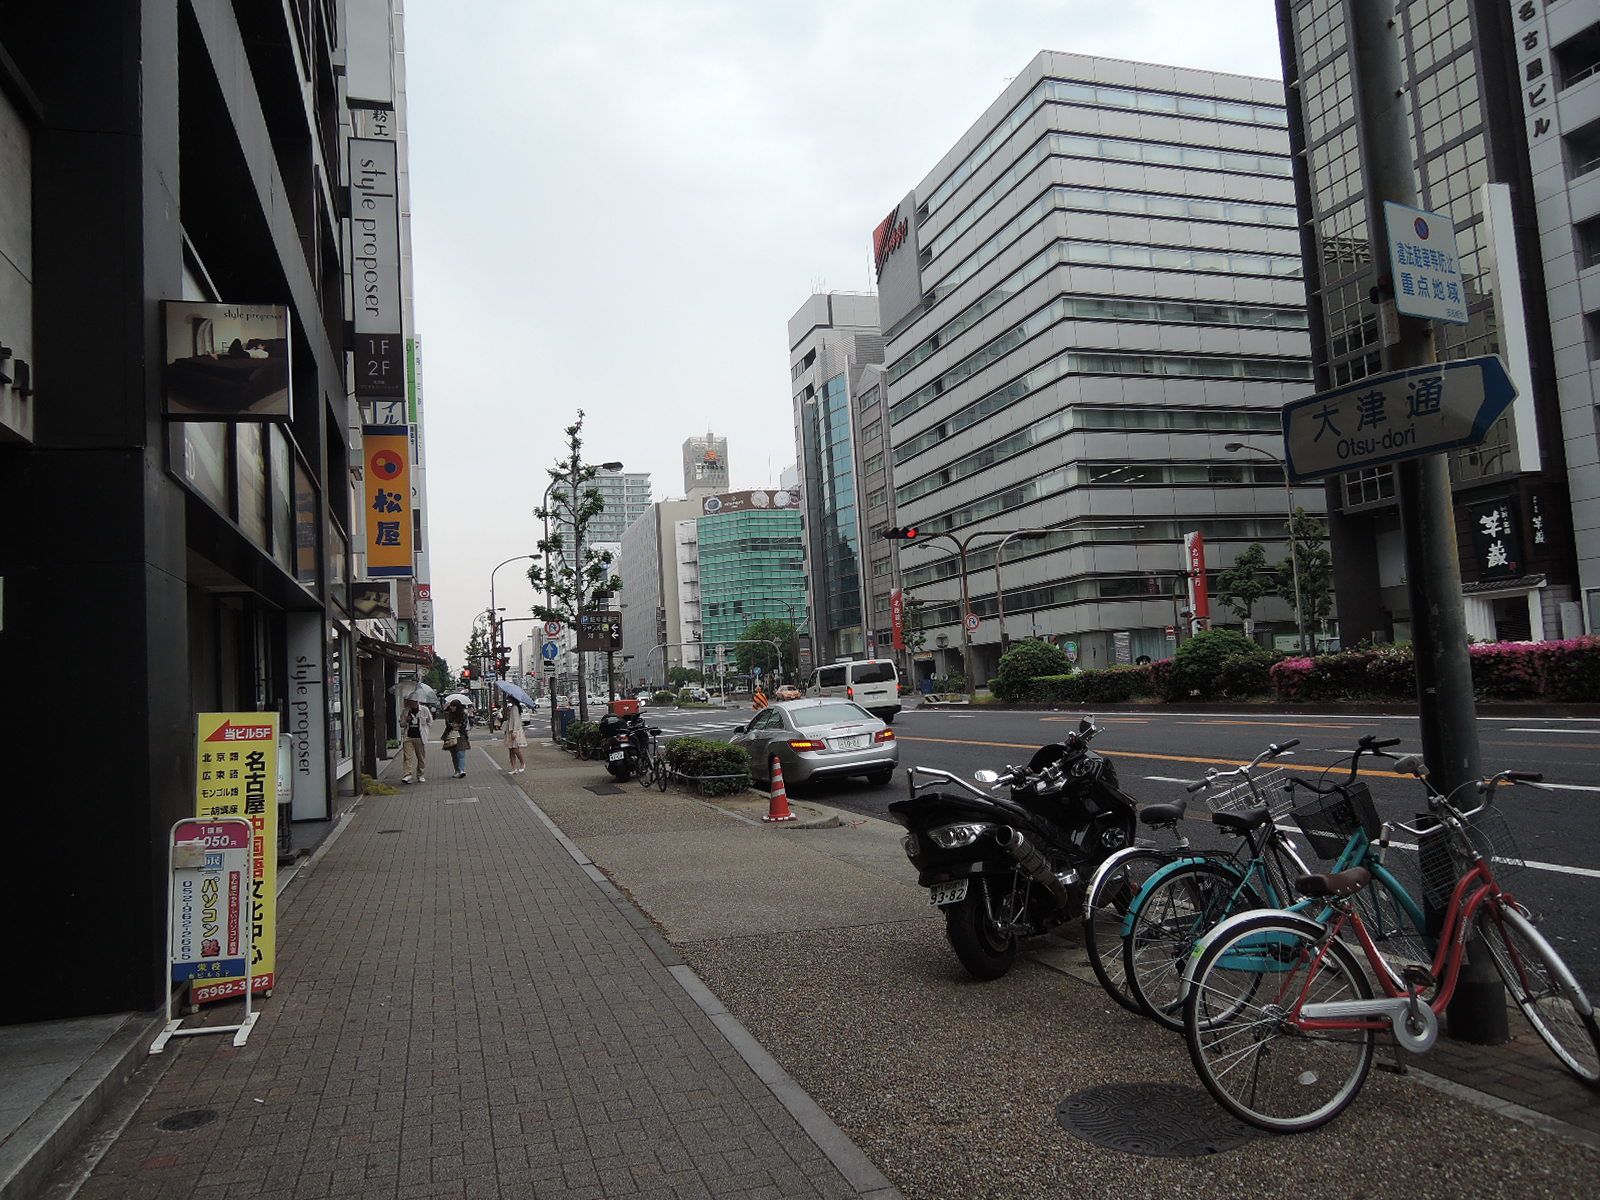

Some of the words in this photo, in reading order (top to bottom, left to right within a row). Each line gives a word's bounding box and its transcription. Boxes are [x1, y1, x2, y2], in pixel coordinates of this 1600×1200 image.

[1518, 0, 1551, 138] 名古屋ビル
[354, 158, 393, 210] style
[354, 219, 380, 318] proposer
[1400, 272, 1461, 305] 重点地域
[223, 308, 245, 321] style
[246, 312, 282, 322] proposer
[368, 339, 389, 355] 1F
[367, 360, 390, 376] 2F
[1312, 376, 1445, 443] 大津通
[1336, 424, 1416, 460] Otsu-dori
[372, 488, 402, 546] 松屋
[290, 655, 321, 695] style
[224, 727, 272, 740] 当ビル5F
[292, 701, 311, 776] proposer
[202, 752, 239, 763] 北京語
[202, 769, 239, 781] 広東語
[201, 787, 239, 799] モンゴル語
[201, 876, 221, 958] パソコン塾
[210, 976, 269, 996] 962-322
